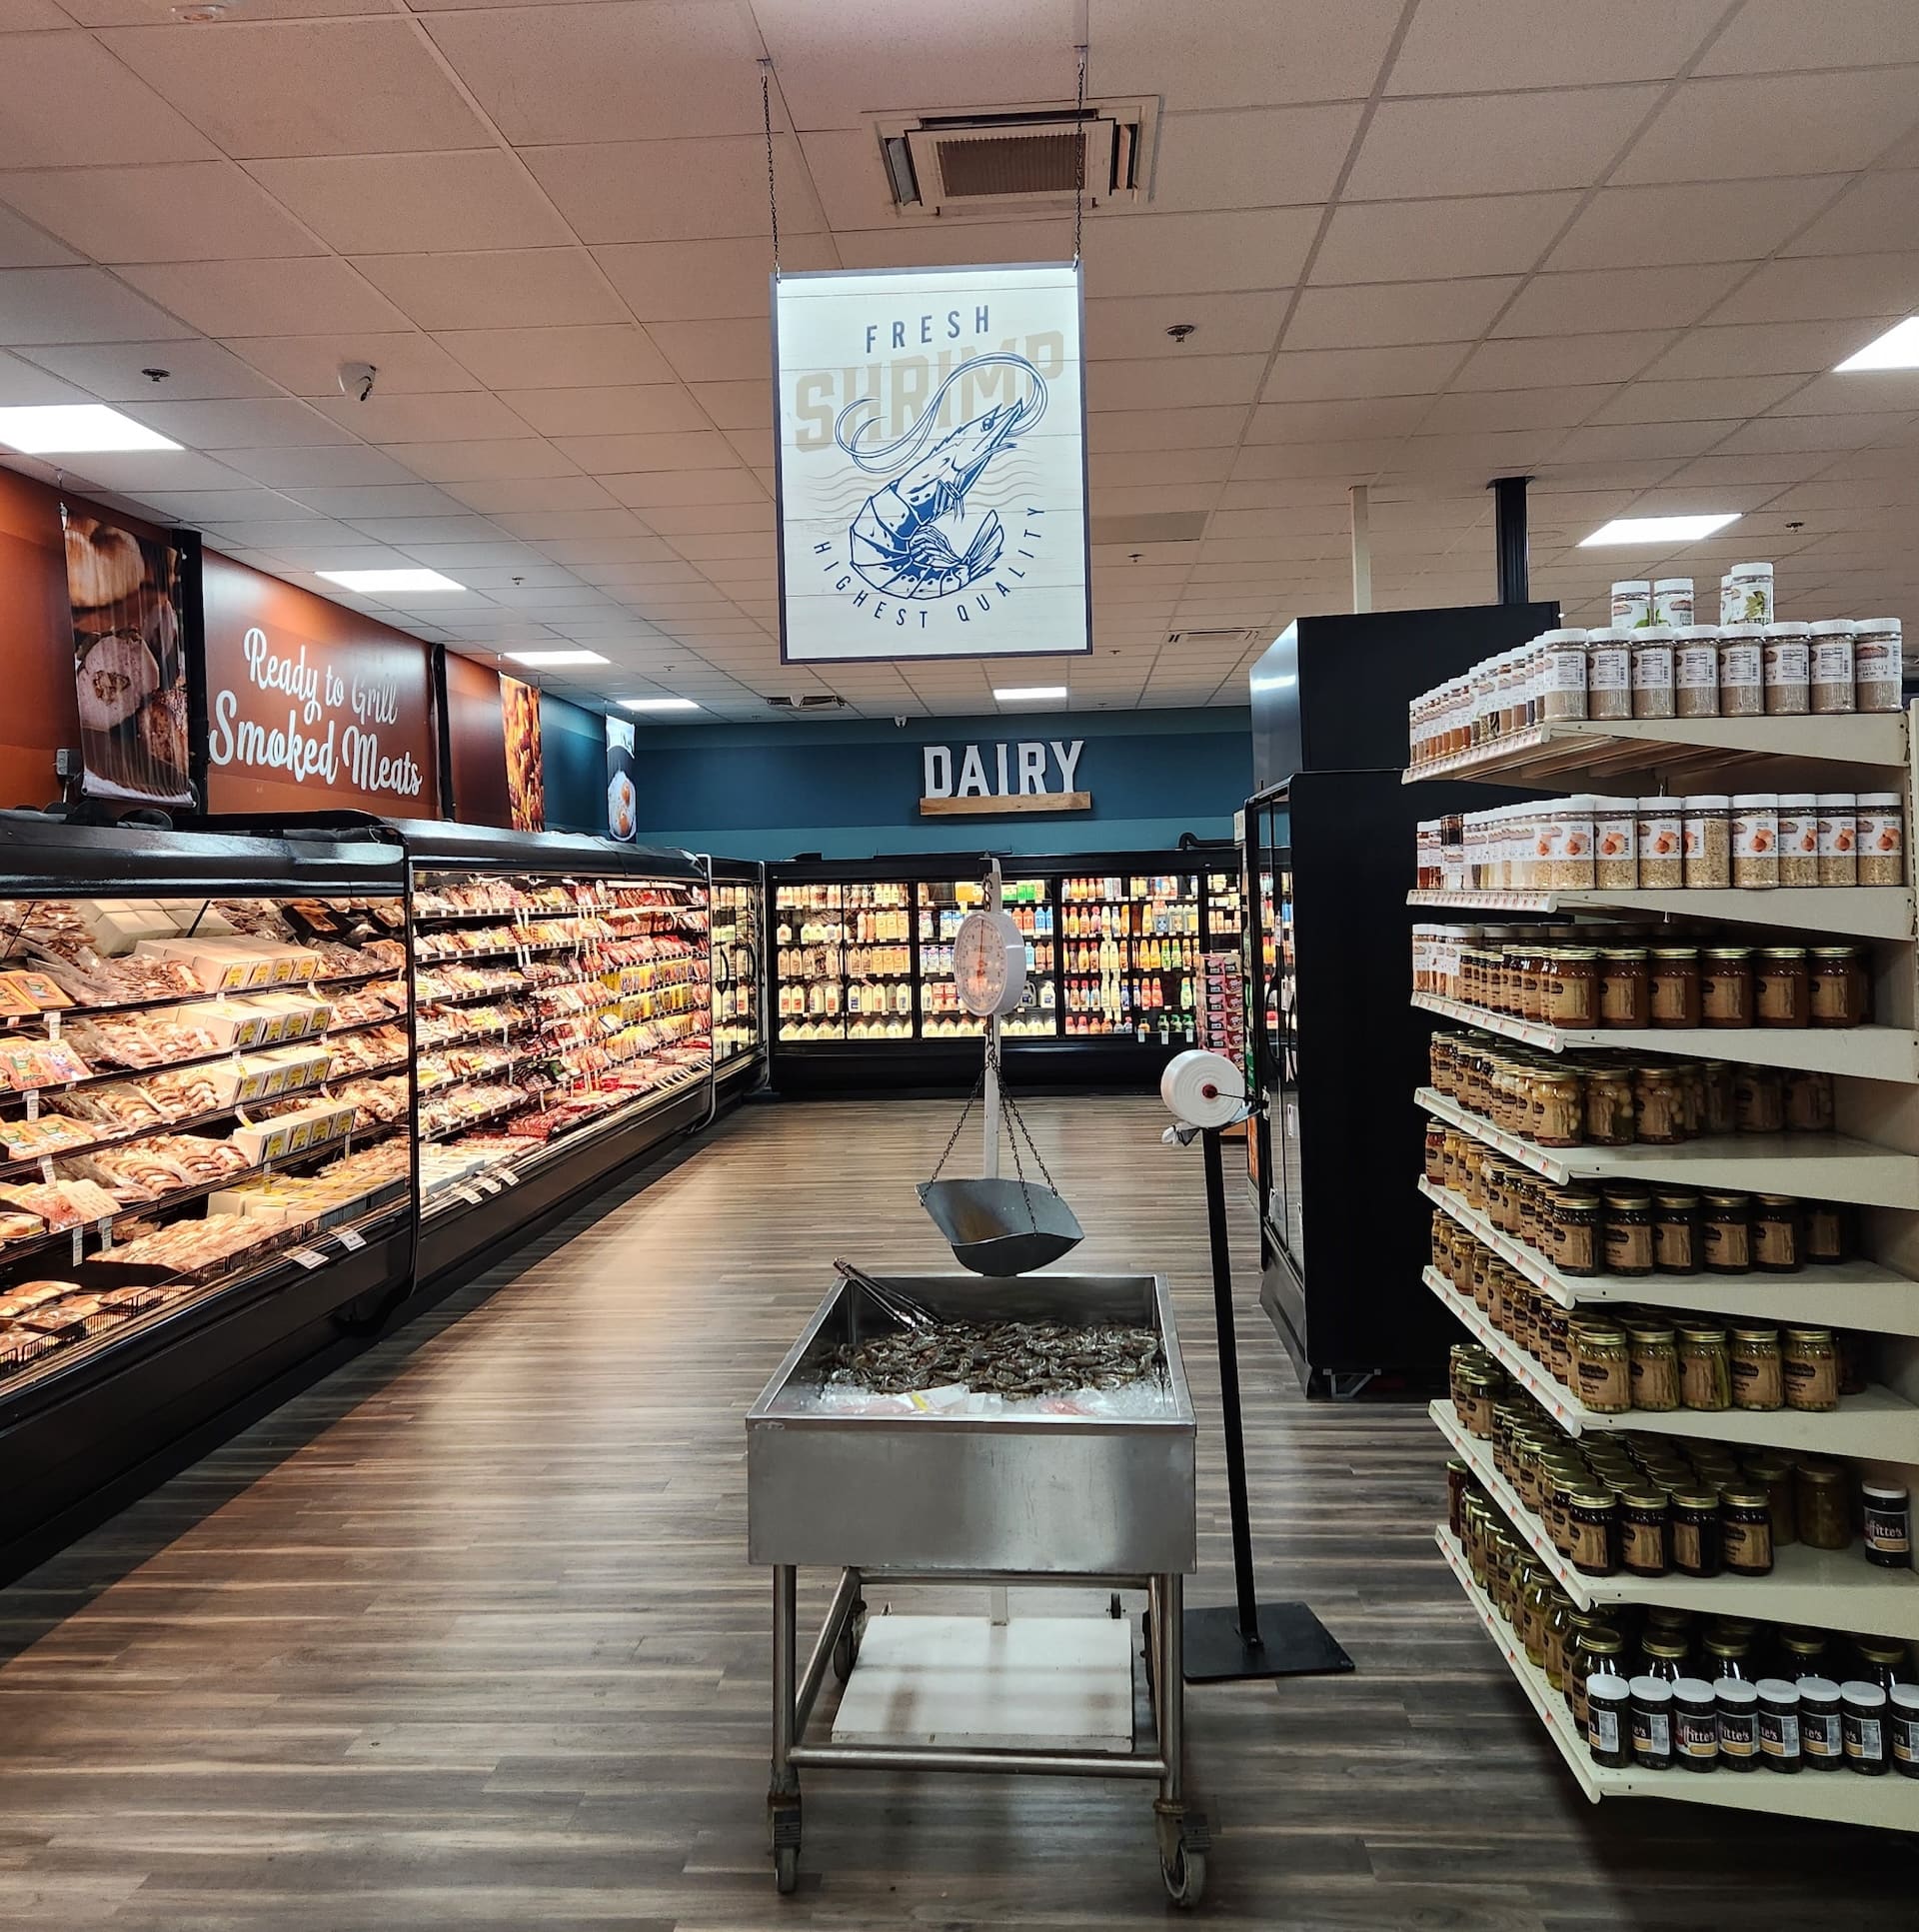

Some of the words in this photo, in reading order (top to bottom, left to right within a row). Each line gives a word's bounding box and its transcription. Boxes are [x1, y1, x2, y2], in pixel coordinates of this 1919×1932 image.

[866, 305, 989, 353] FRESH
[795, 330, 1064, 453] SHRIMP
[813, 540, 929, 629] HIGHEST
[957, 507, 1045, 622] QUALITY
[243, 627, 322, 725] Ready
[326, 665, 344, 707] to
[352, 672, 398, 725] Grill
[209, 690, 338, 785] Smoked
[342, 725, 423, 796] Meats
[923, 740, 1085, 799] DAIRY
